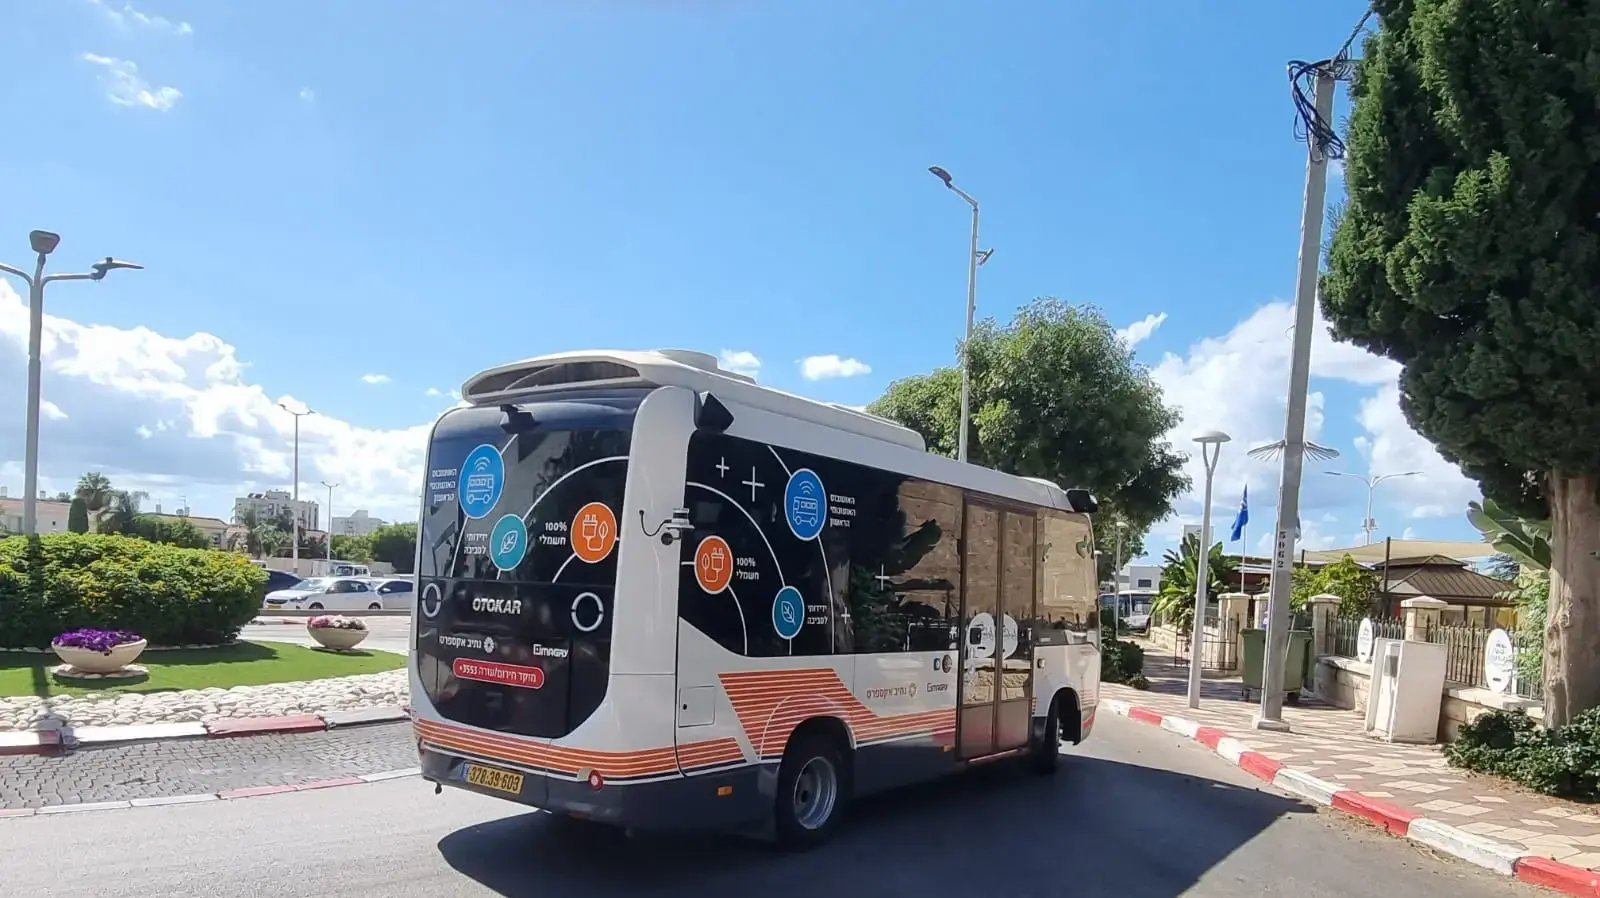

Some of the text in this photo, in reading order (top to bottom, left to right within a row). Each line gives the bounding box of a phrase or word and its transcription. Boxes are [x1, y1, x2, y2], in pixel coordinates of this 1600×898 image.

[545, 521, 567, 531] 100%
[539, 534, 566, 544] חשמלי
[464, 545, 486, 554] לסביבה
[736, 557, 755, 566] 100%
[736, 569, 759, 580] חשמלי
[472, 598, 521, 614] OTOKAR
[807, 616, 828, 624] לסביבה
[467, 639, 482, 648] נתיב
[518, 672, 536, 684] מוקד
